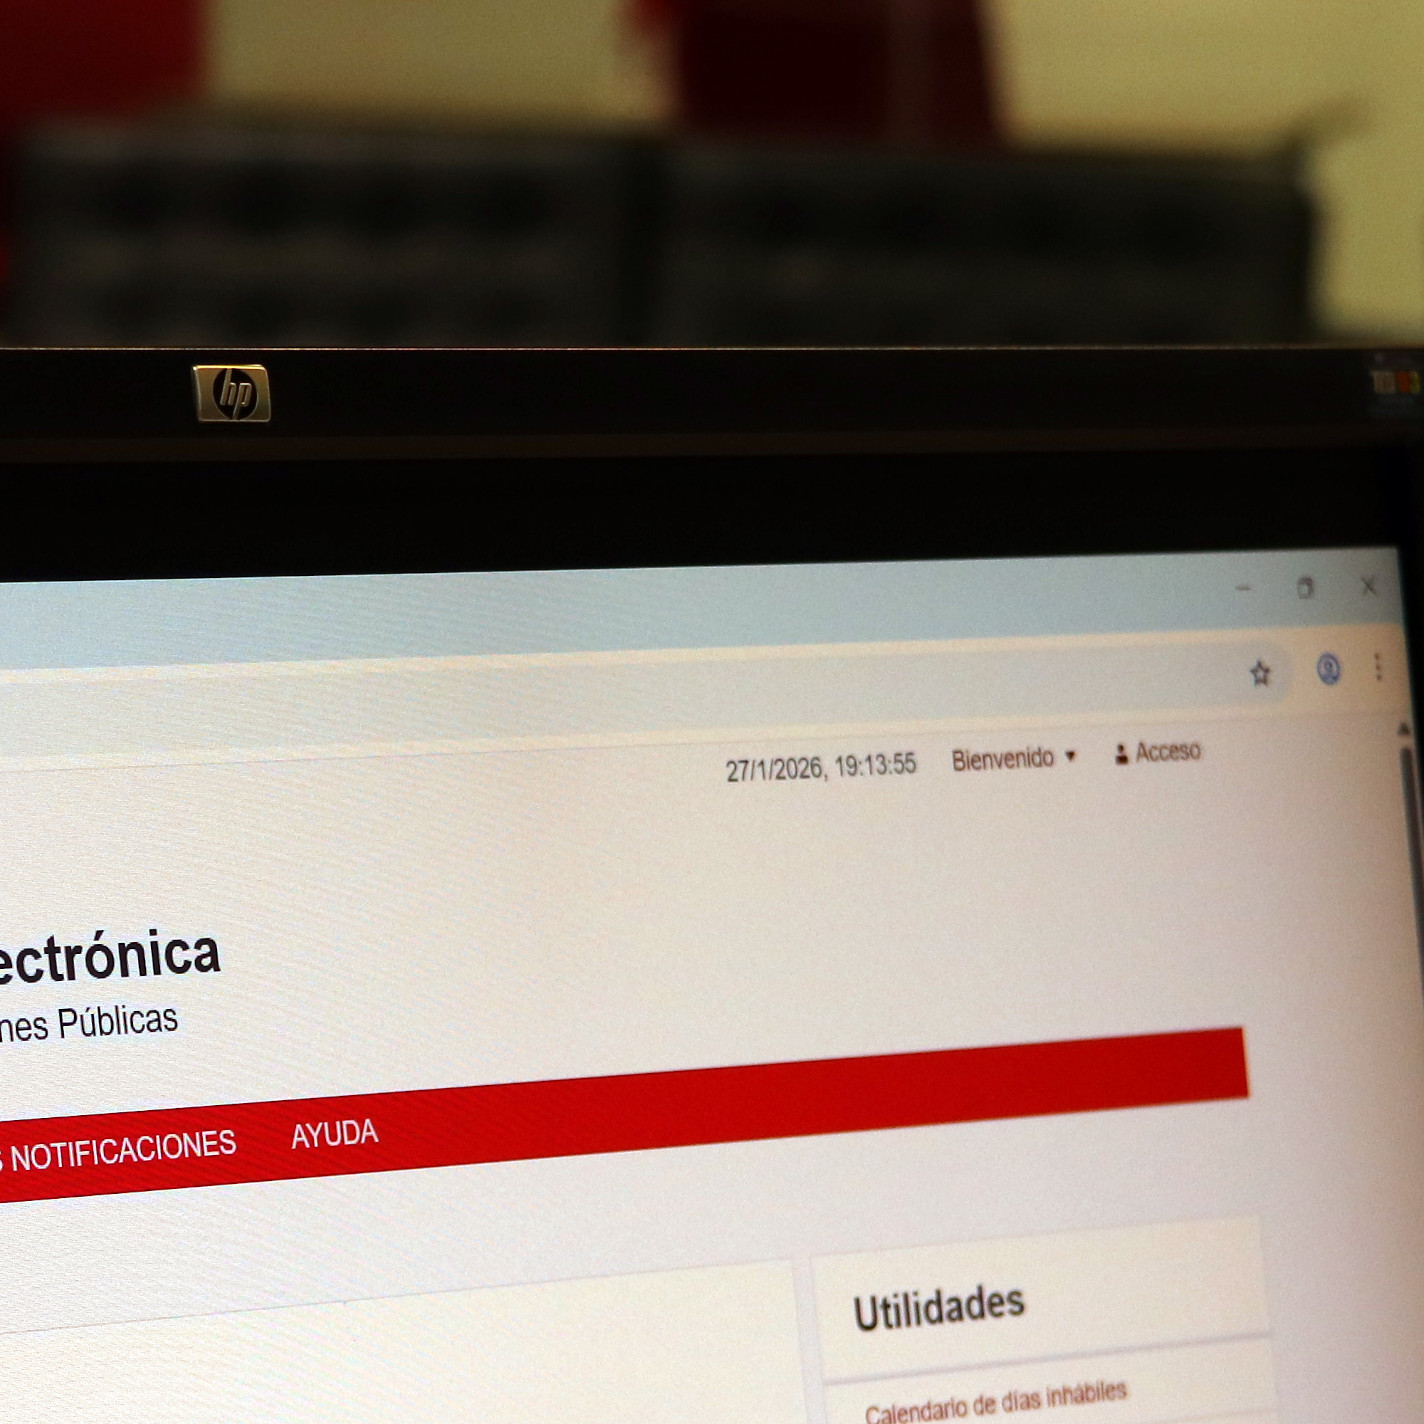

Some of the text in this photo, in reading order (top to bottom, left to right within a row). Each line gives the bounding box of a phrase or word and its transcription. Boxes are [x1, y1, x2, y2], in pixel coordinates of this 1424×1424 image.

[219, 368, 253, 421] hp
[725, 751, 918, 784] 27/1/2026, 19:13:55
[951, 746, 1055, 773] Bienvenido
[1135, 741, 1202, 763] Acceso
[58, 1005, 179, 1039] Públicas
[10, 1129, 237, 1172] NOTIFICACIONES
[290, 1117, 380, 1150] AYUDA
[854, 1284, 1026, 1333] Utilidades
[972, 1394, 997, 1417] de
[1001, 1390, 1043, 1413] días
[1045, 1380, 1129, 1408] inhábiles
